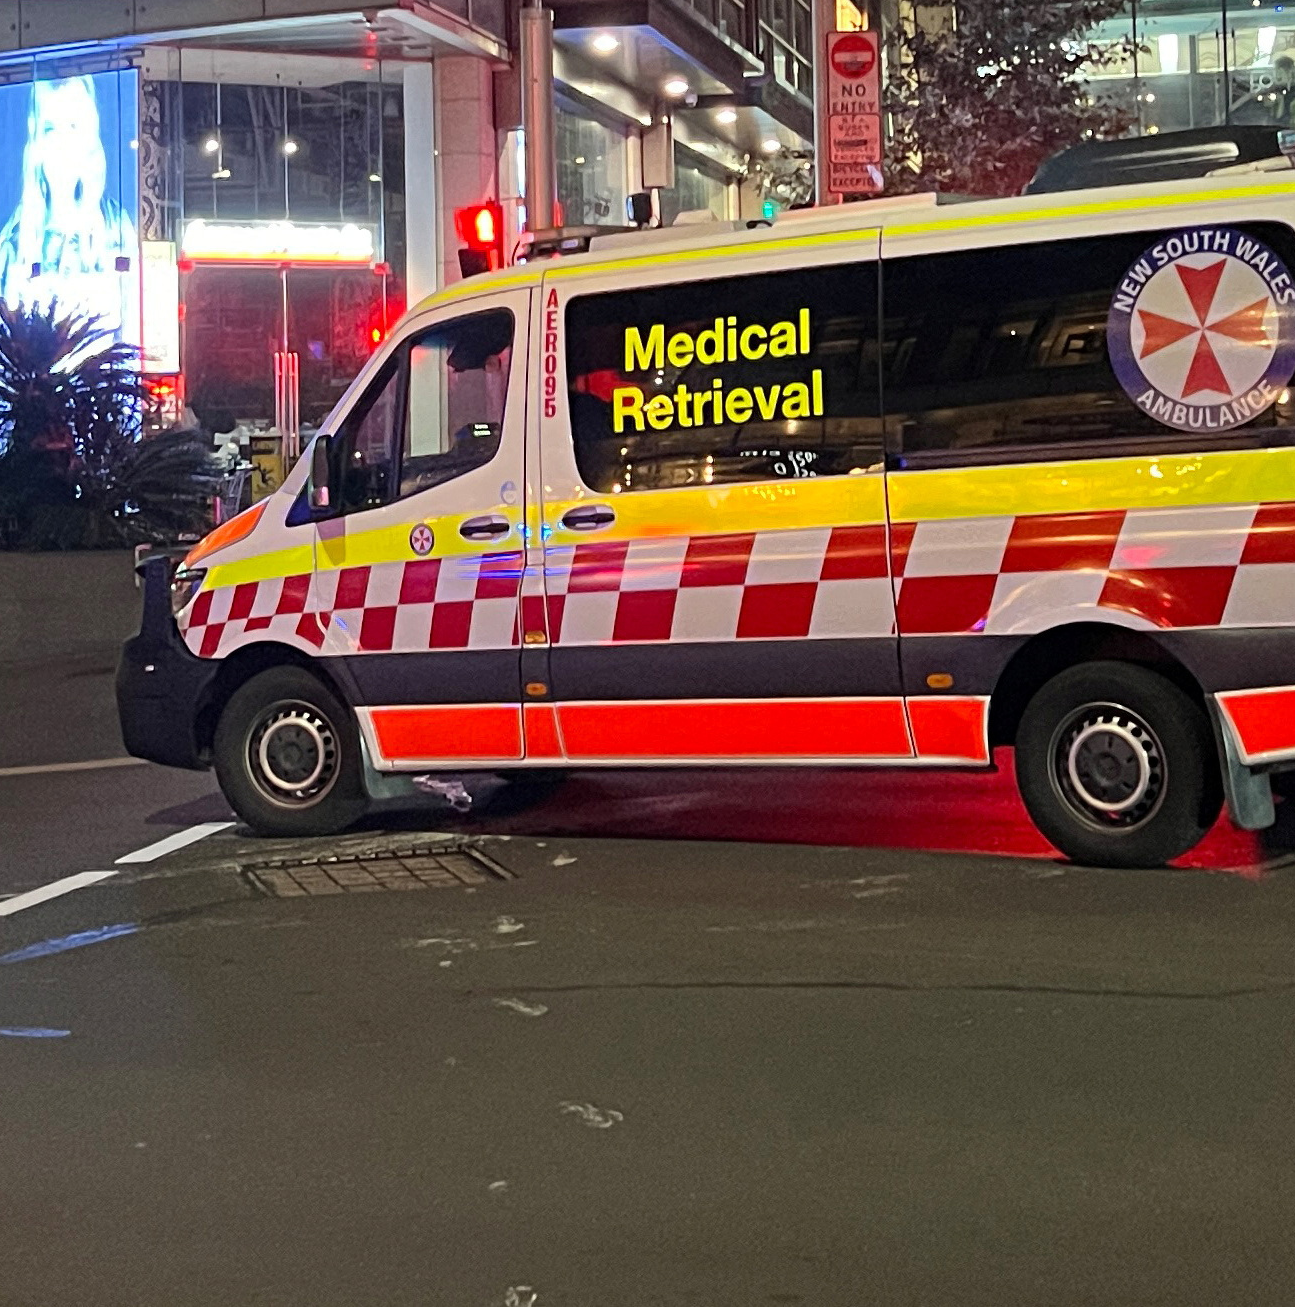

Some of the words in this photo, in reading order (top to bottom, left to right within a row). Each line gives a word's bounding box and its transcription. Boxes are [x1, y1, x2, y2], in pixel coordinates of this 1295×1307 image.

[841, 83, 866, 97] NO
[1114, 259, 1154, 313] NEW
[1152, 230, 1230, 266] SOUTH
[1235, 236, 1295, 305] WALES
[544, 288, 559, 418] AERO95
[624, 308, 811, 372] Medical
[612, 369, 824, 433] Retrieval
[1137, 379, 1279, 429] AMBULANCE
